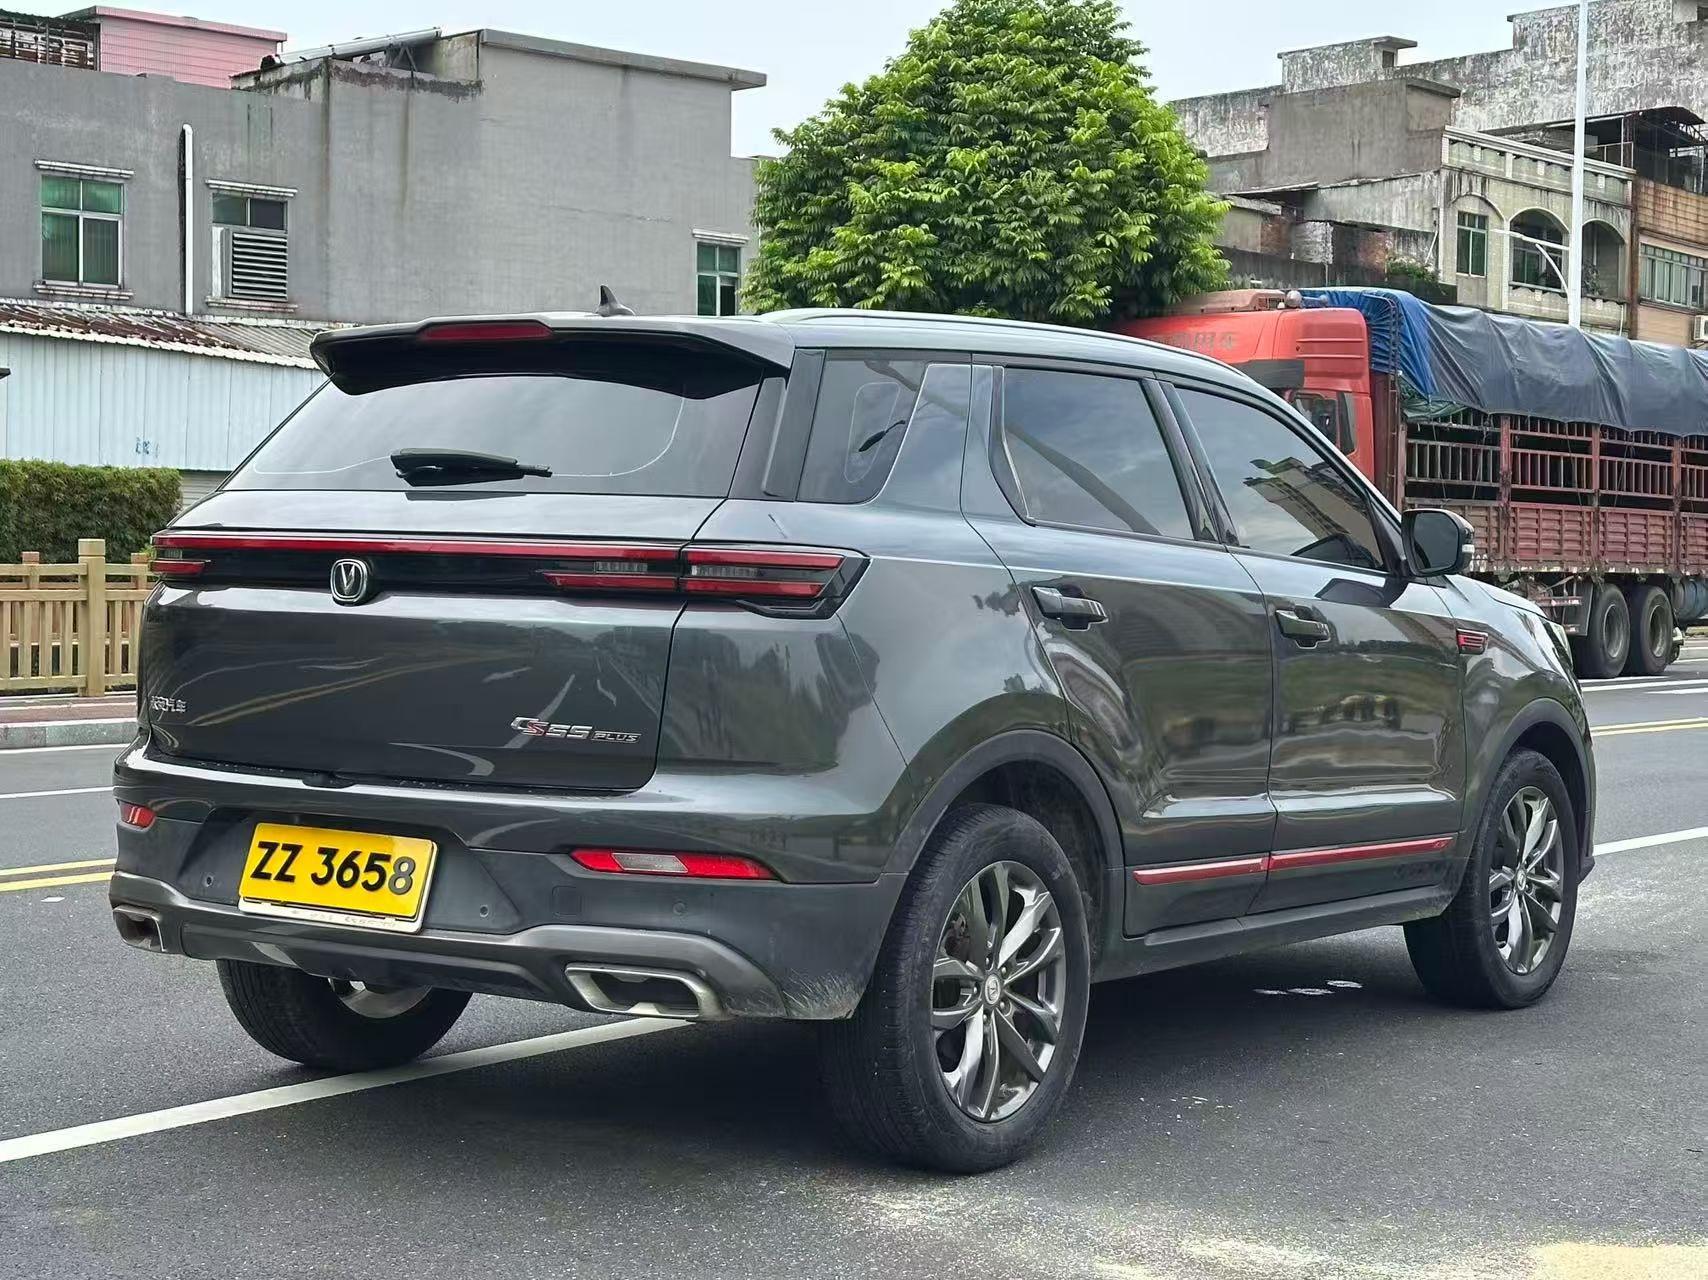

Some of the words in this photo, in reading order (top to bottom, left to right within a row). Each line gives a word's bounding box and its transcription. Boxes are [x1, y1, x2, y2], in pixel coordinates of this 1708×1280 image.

[510, 717, 593, 740] CS55
[592, 731, 640, 743] PLUS
[250, 841, 303, 883] ZZ
[310, 847, 416, 895] 3658
